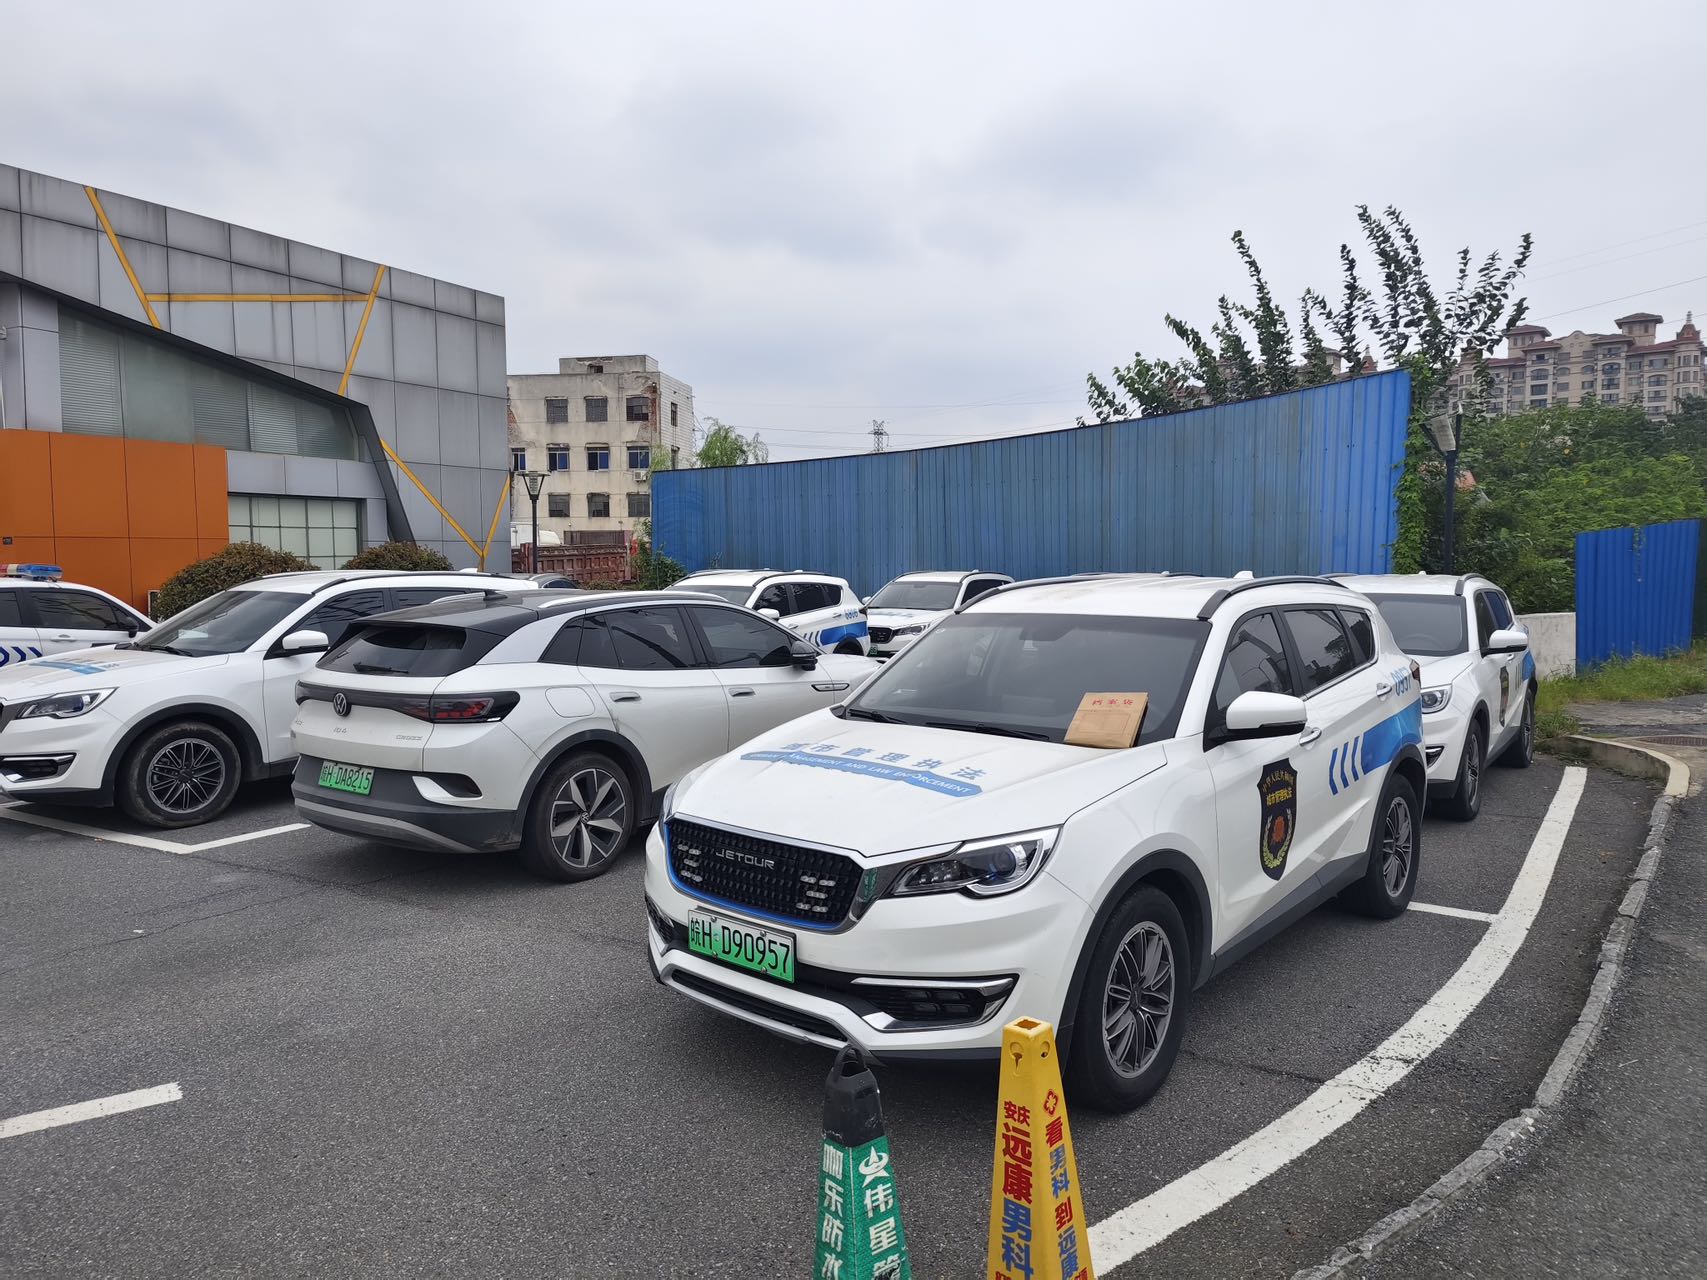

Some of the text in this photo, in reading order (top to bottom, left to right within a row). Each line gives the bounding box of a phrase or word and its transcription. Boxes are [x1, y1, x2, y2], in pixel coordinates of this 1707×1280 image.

[845, 762, 869, 770] AND
[868, 765, 894, 775] LAW
[715, 849, 775, 870] JETOUR
